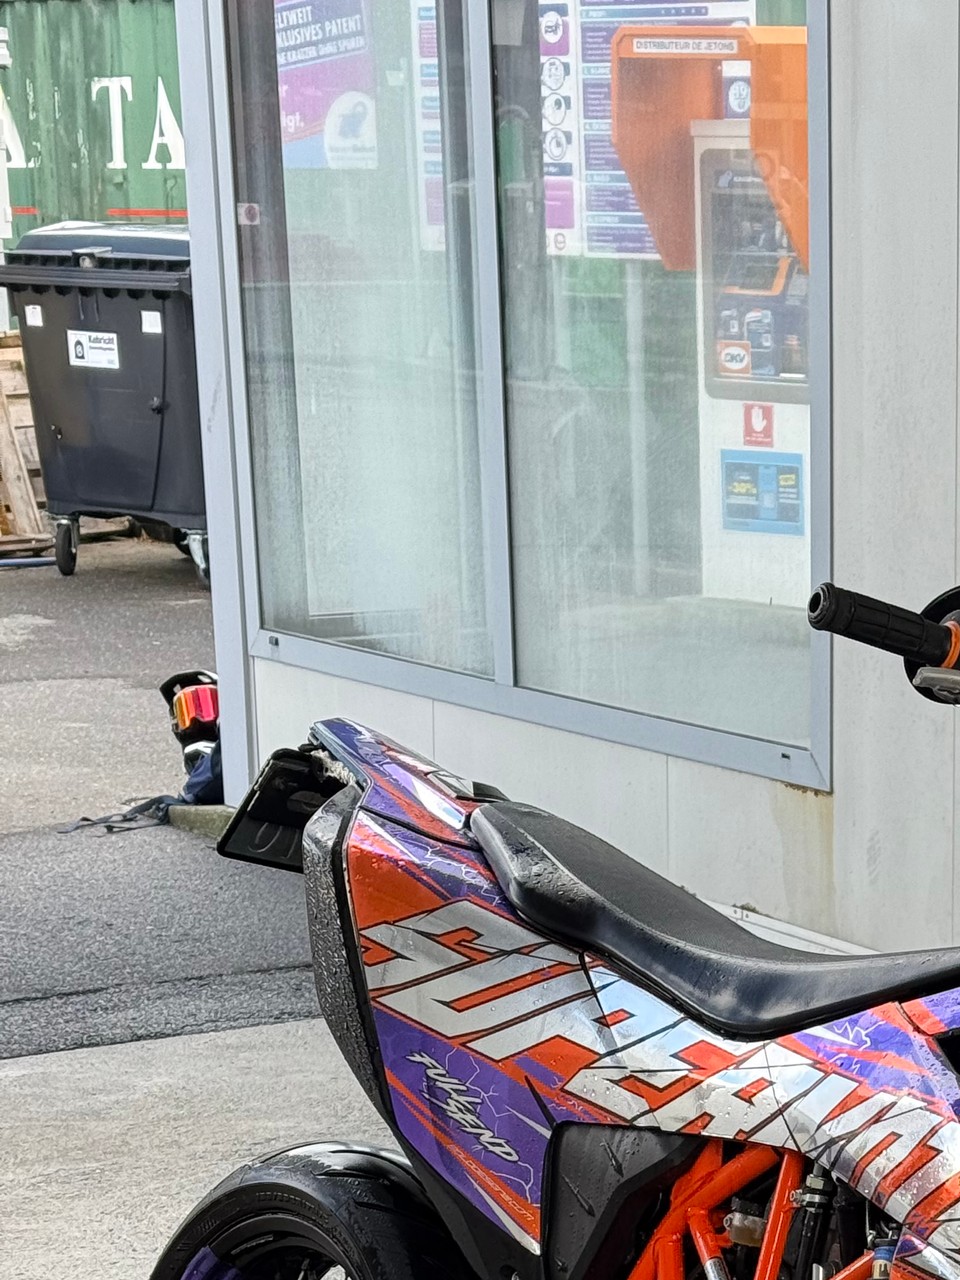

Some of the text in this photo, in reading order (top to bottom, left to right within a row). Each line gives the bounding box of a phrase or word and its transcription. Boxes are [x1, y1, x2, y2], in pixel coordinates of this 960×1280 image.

[325, 15, 362, 38] PATENT
[636, 40, 734, 51] DISTRIBUTEUR DE JETONS
[405, 1051, 483, 1104] FULL
[420, 1092, 520, 1162] SEND
